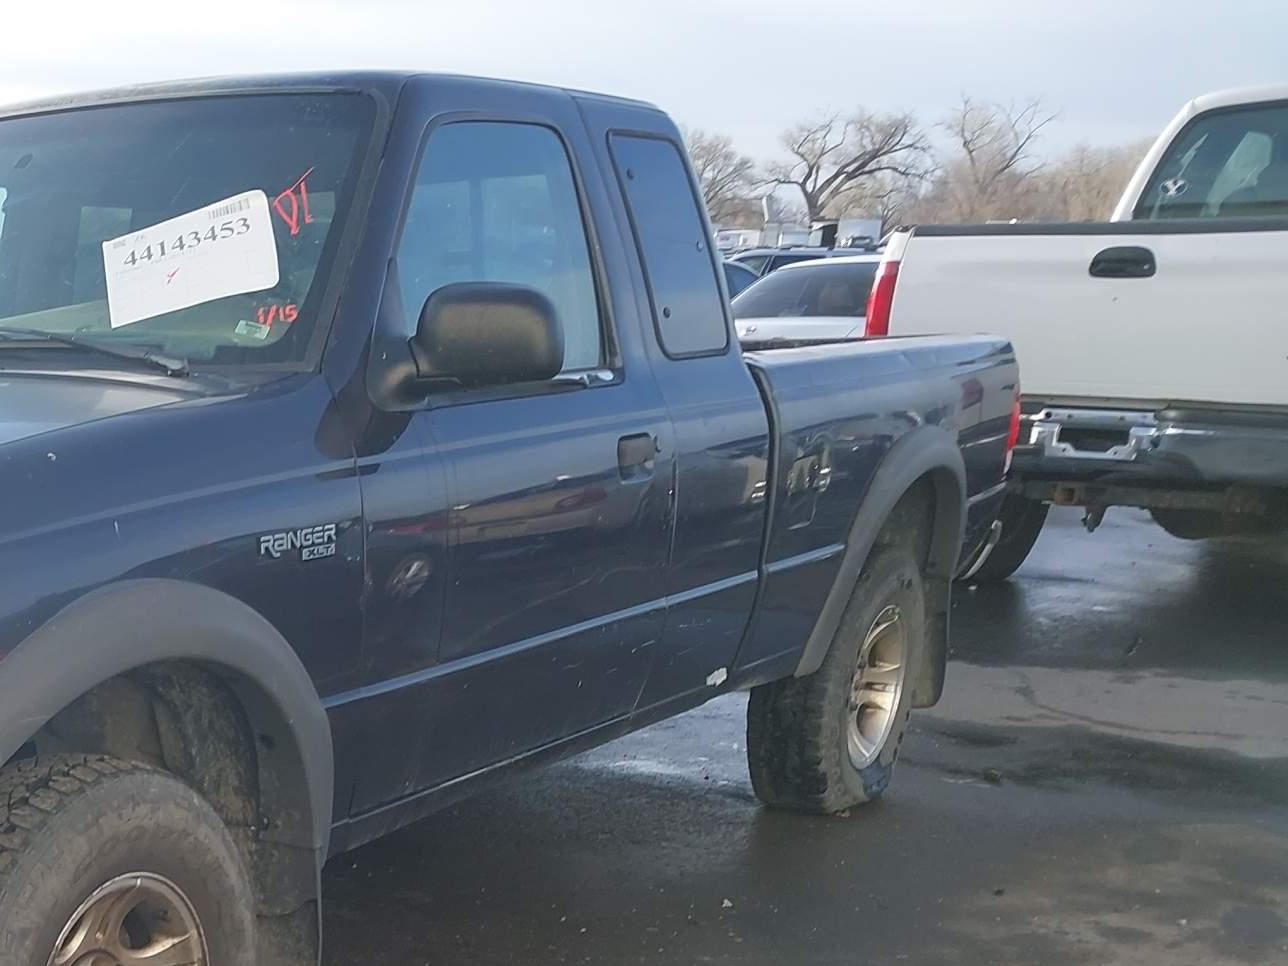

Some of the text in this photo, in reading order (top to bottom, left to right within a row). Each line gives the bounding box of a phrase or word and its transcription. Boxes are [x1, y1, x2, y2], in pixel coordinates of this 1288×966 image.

[123, 216, 251, 267] 44143453
[257, 304, 297, 327] 1/15
[260, 524, 337, 558] RANGER
